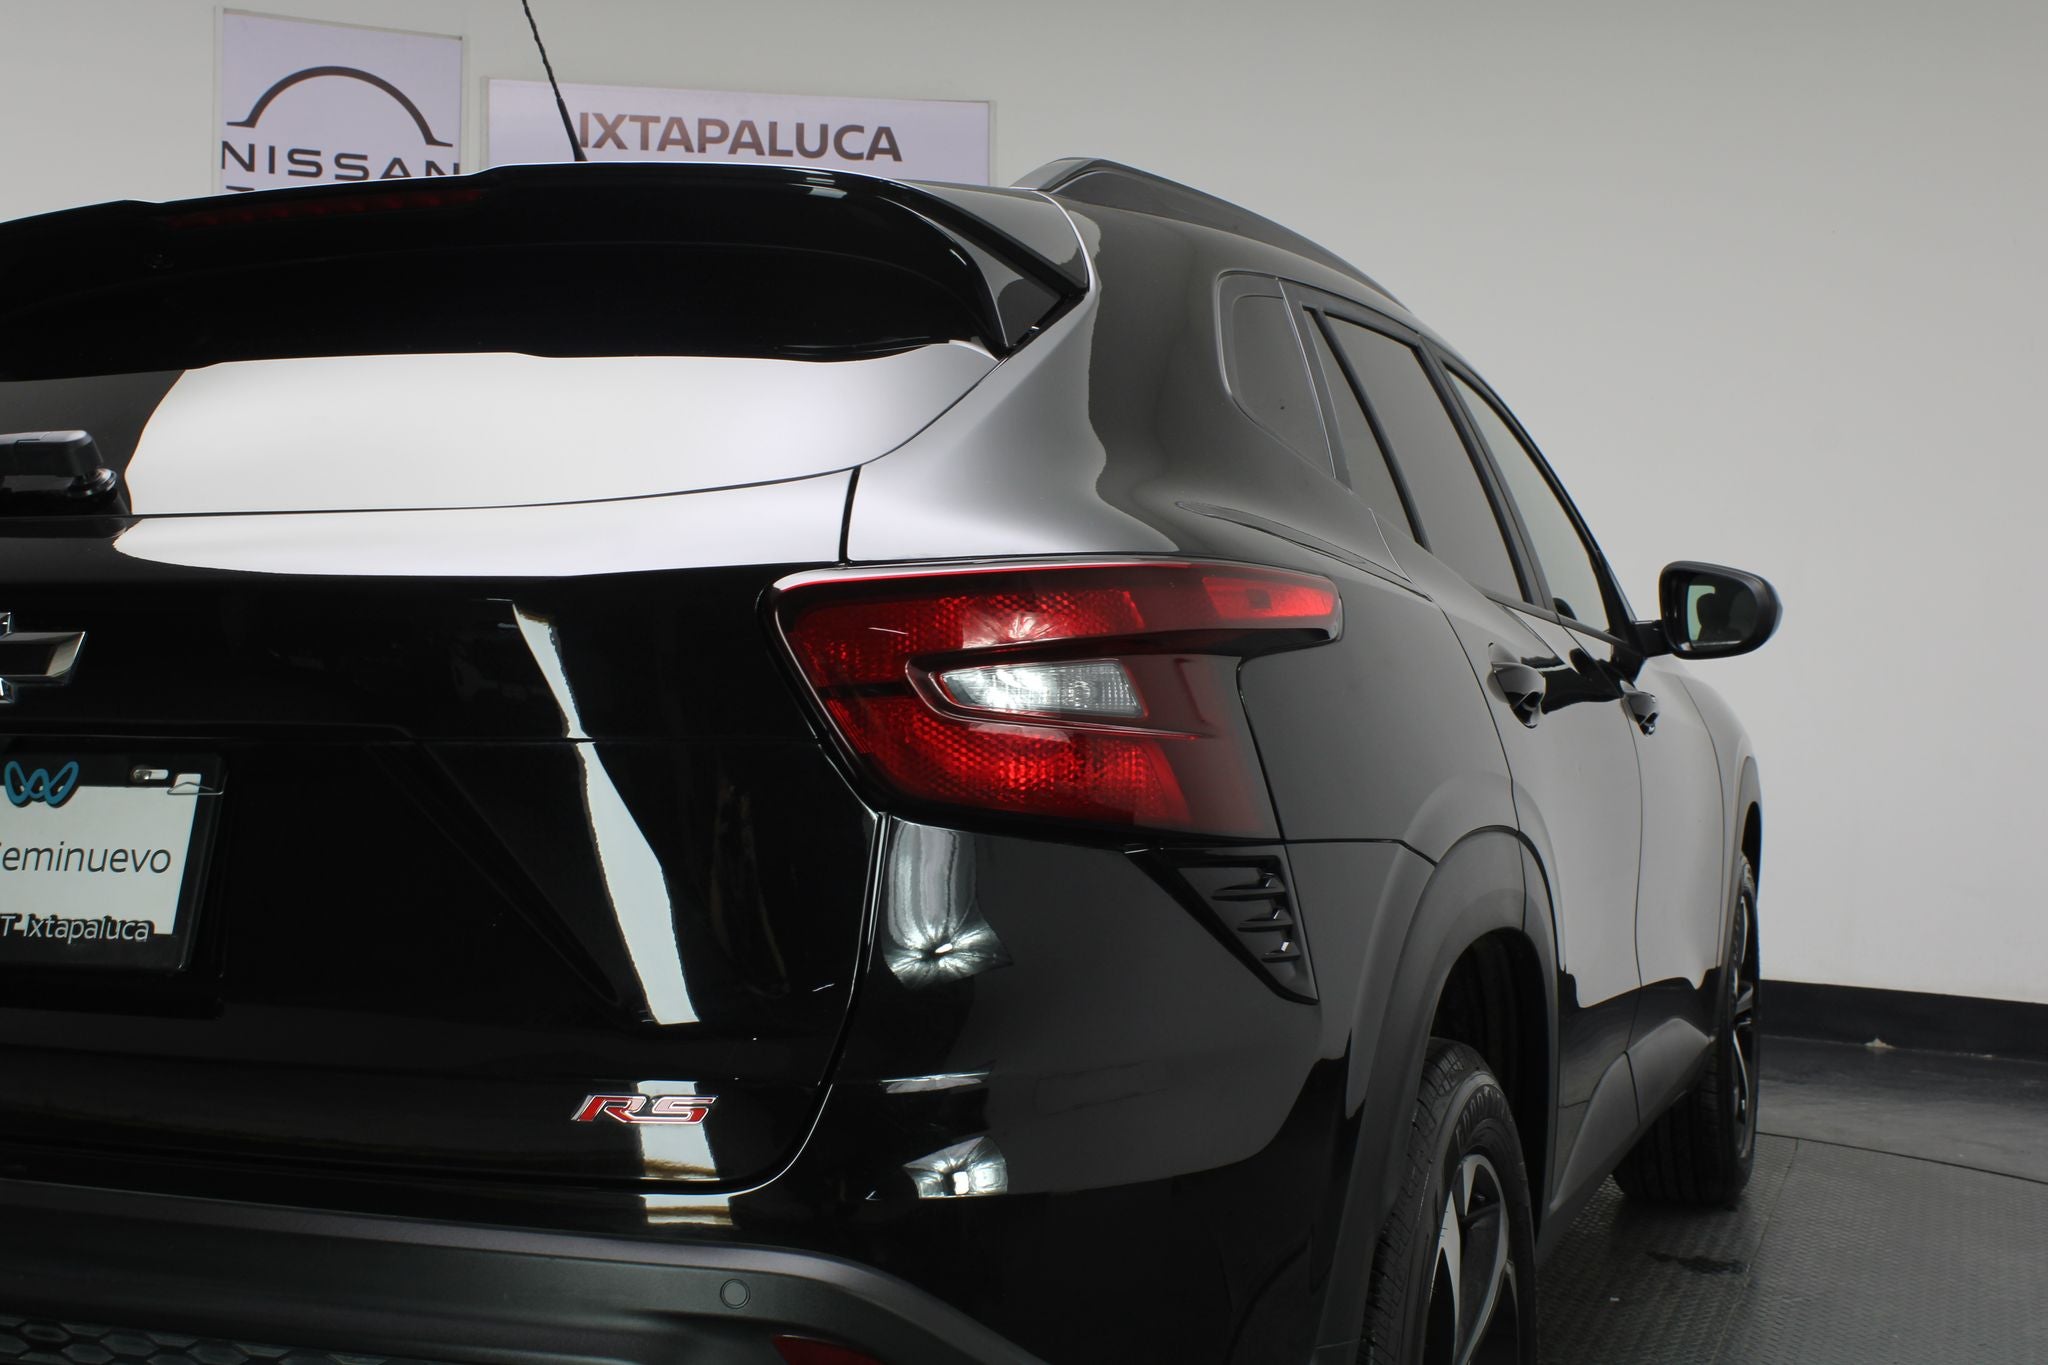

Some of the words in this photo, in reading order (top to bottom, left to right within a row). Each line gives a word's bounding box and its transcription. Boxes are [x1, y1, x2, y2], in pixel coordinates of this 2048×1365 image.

[580, 111, 903, 163] IXTAPALUCA
[0, 841, 172, 874] eminuevo
[571, 1094, 719, 1125] RS
